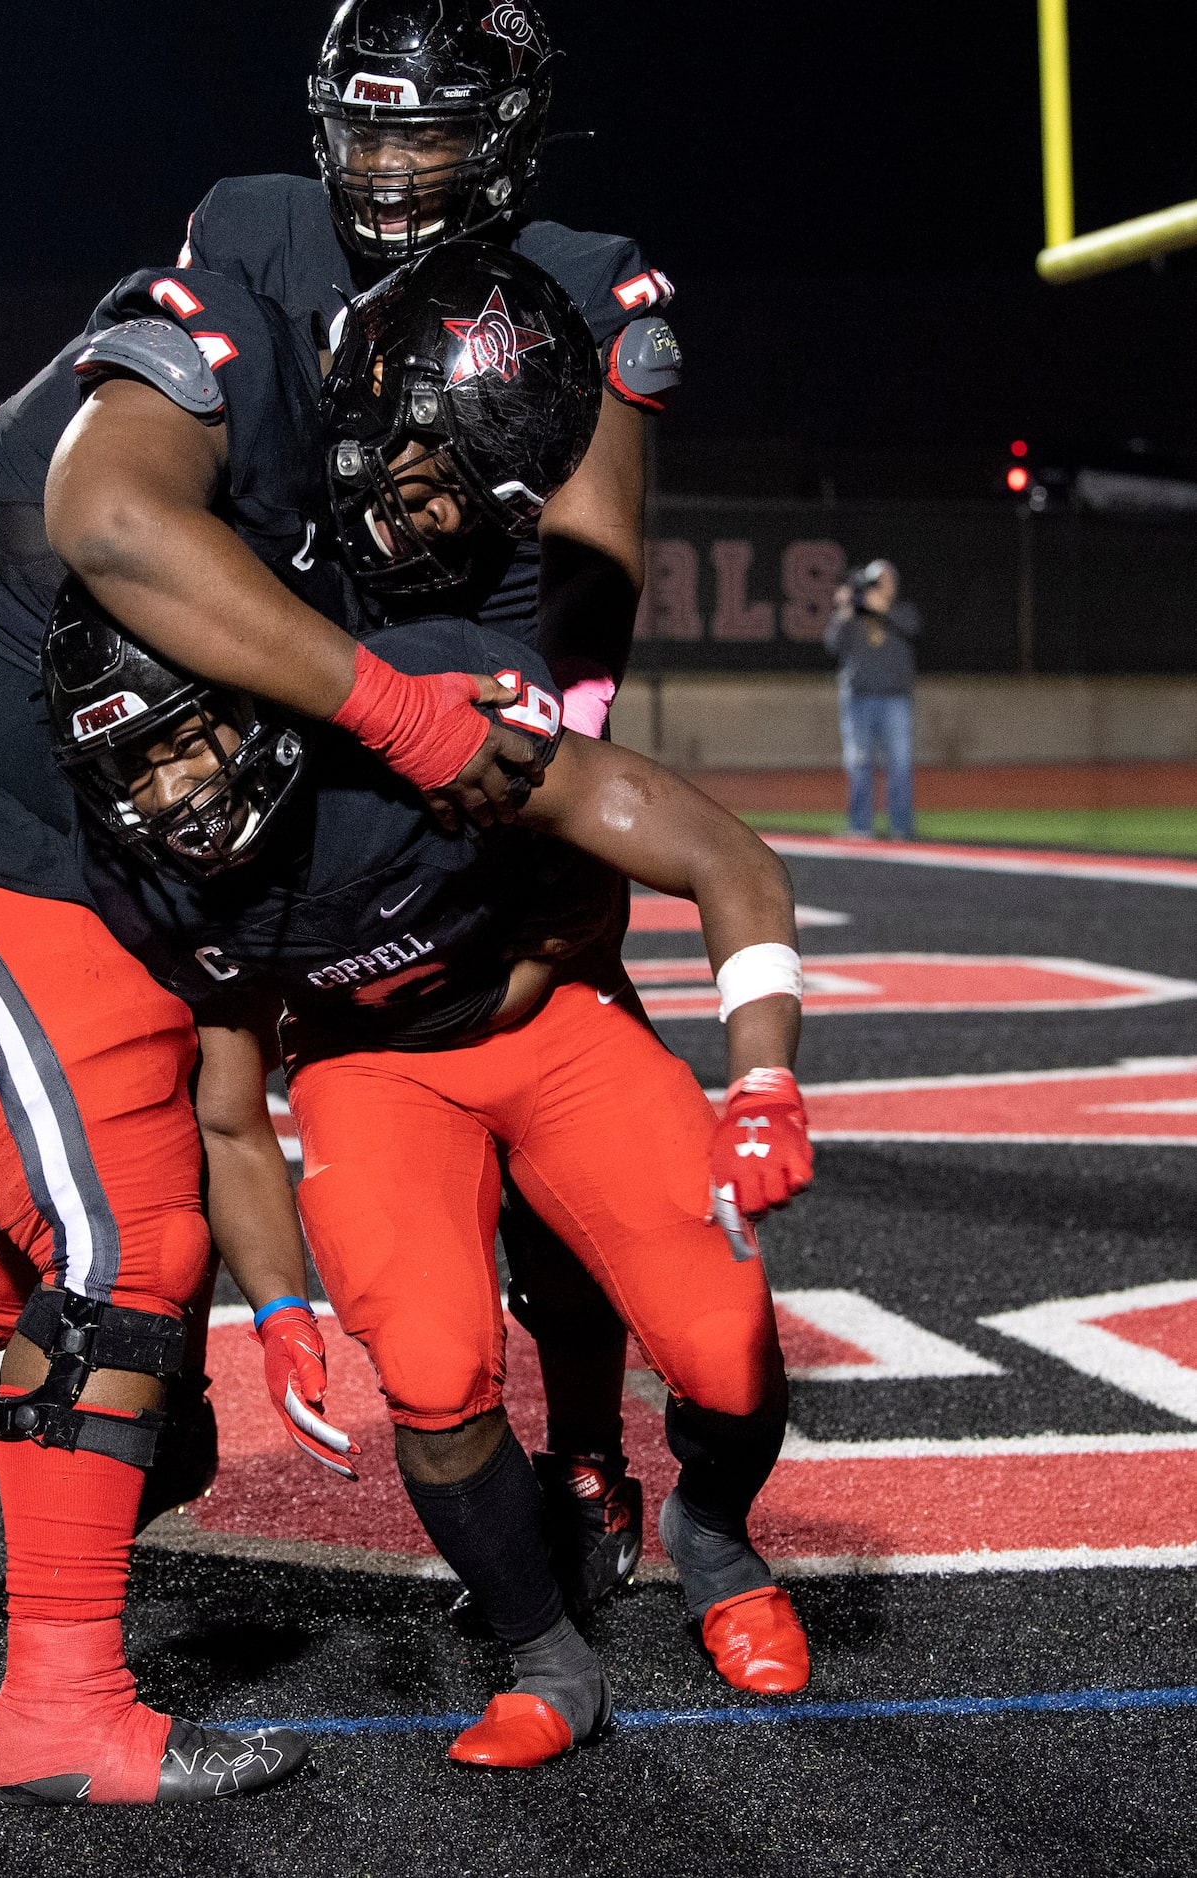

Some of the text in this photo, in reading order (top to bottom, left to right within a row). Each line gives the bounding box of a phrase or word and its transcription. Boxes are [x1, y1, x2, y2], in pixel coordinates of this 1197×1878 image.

[353, 79, 404, 105] FIGHT
[76, 694, 130, 736] FIGHT
[194, 945, 240, 982] C
[306, 932, 436, 990] COPPELL
